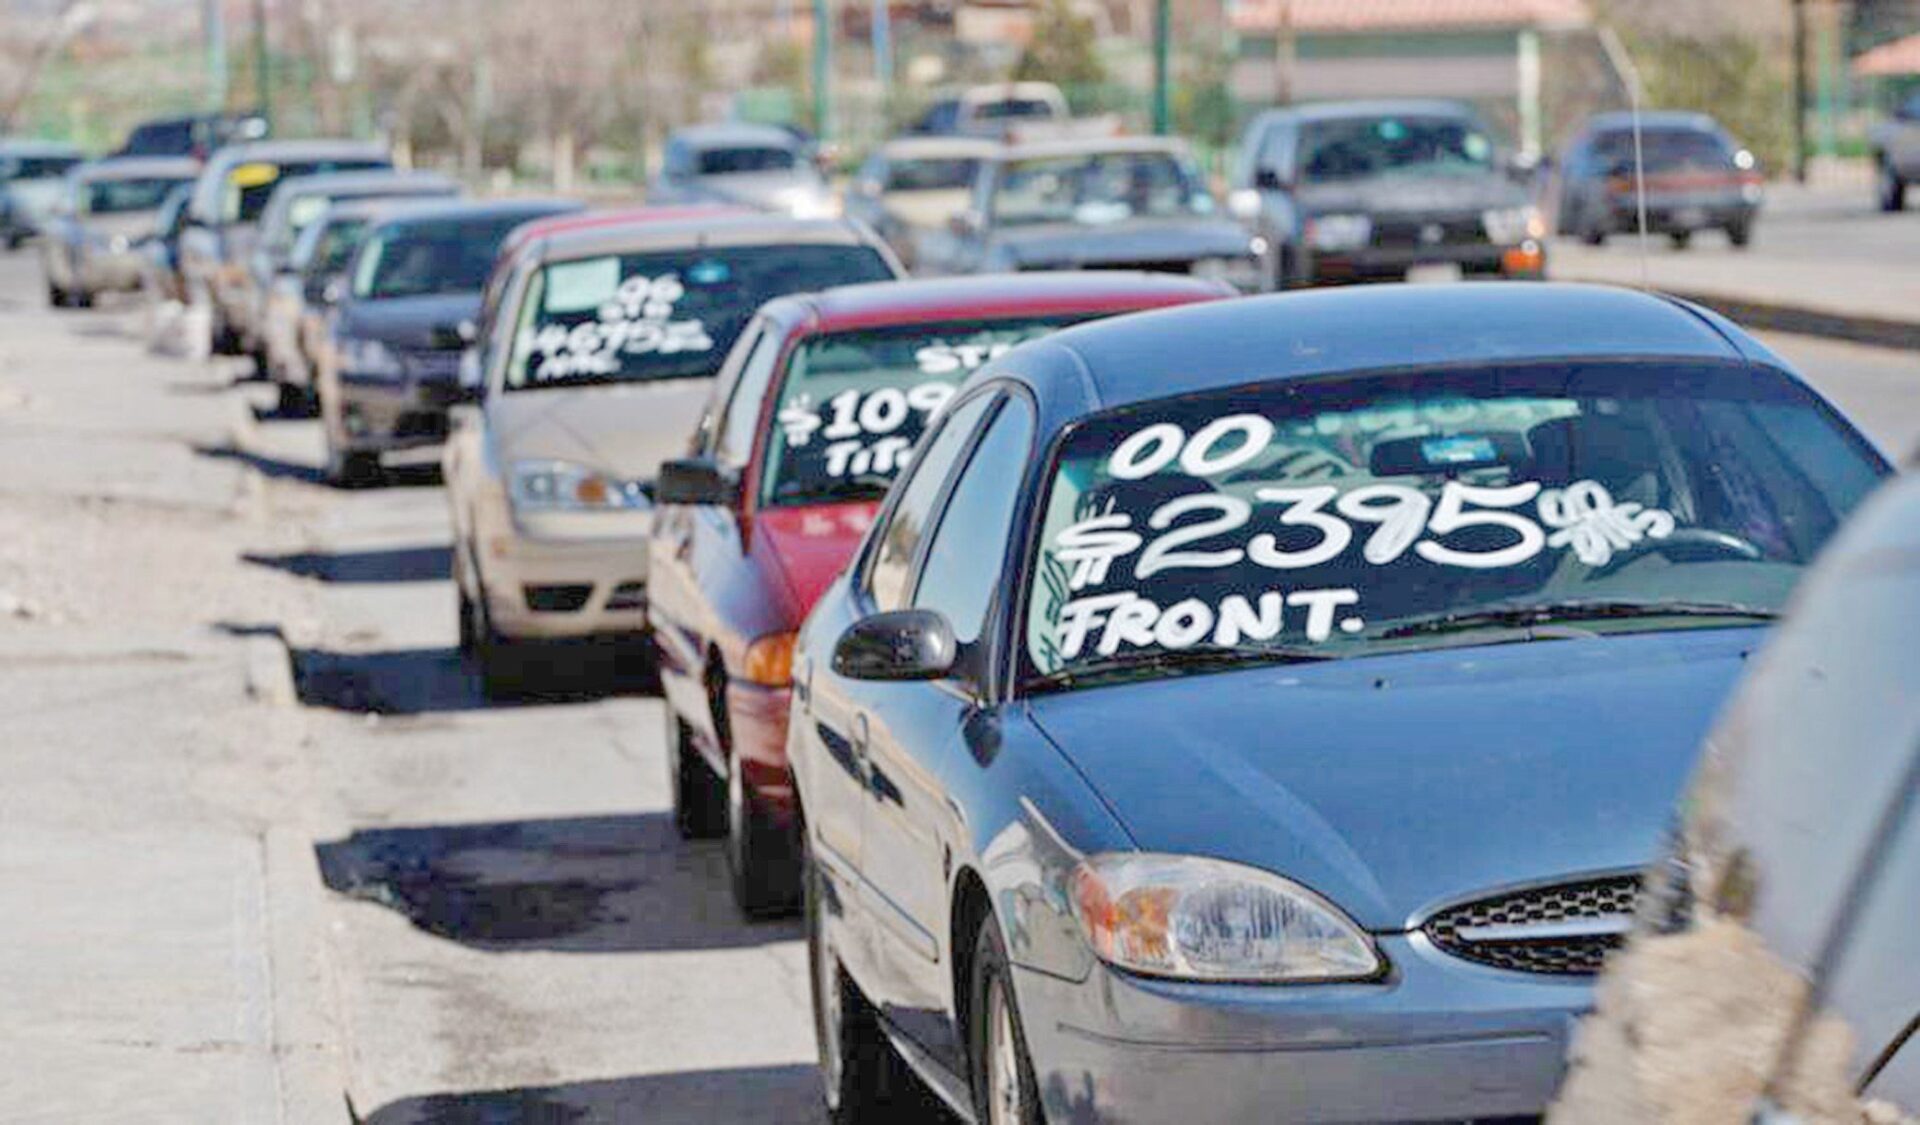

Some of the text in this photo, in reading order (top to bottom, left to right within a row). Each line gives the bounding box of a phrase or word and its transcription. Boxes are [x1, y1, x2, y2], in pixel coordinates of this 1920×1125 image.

[1107, 413, 1275, 479] 00
[1053, 480, 1545, 591] $2395
[1056, 589, 1364, 658] FRONT.
